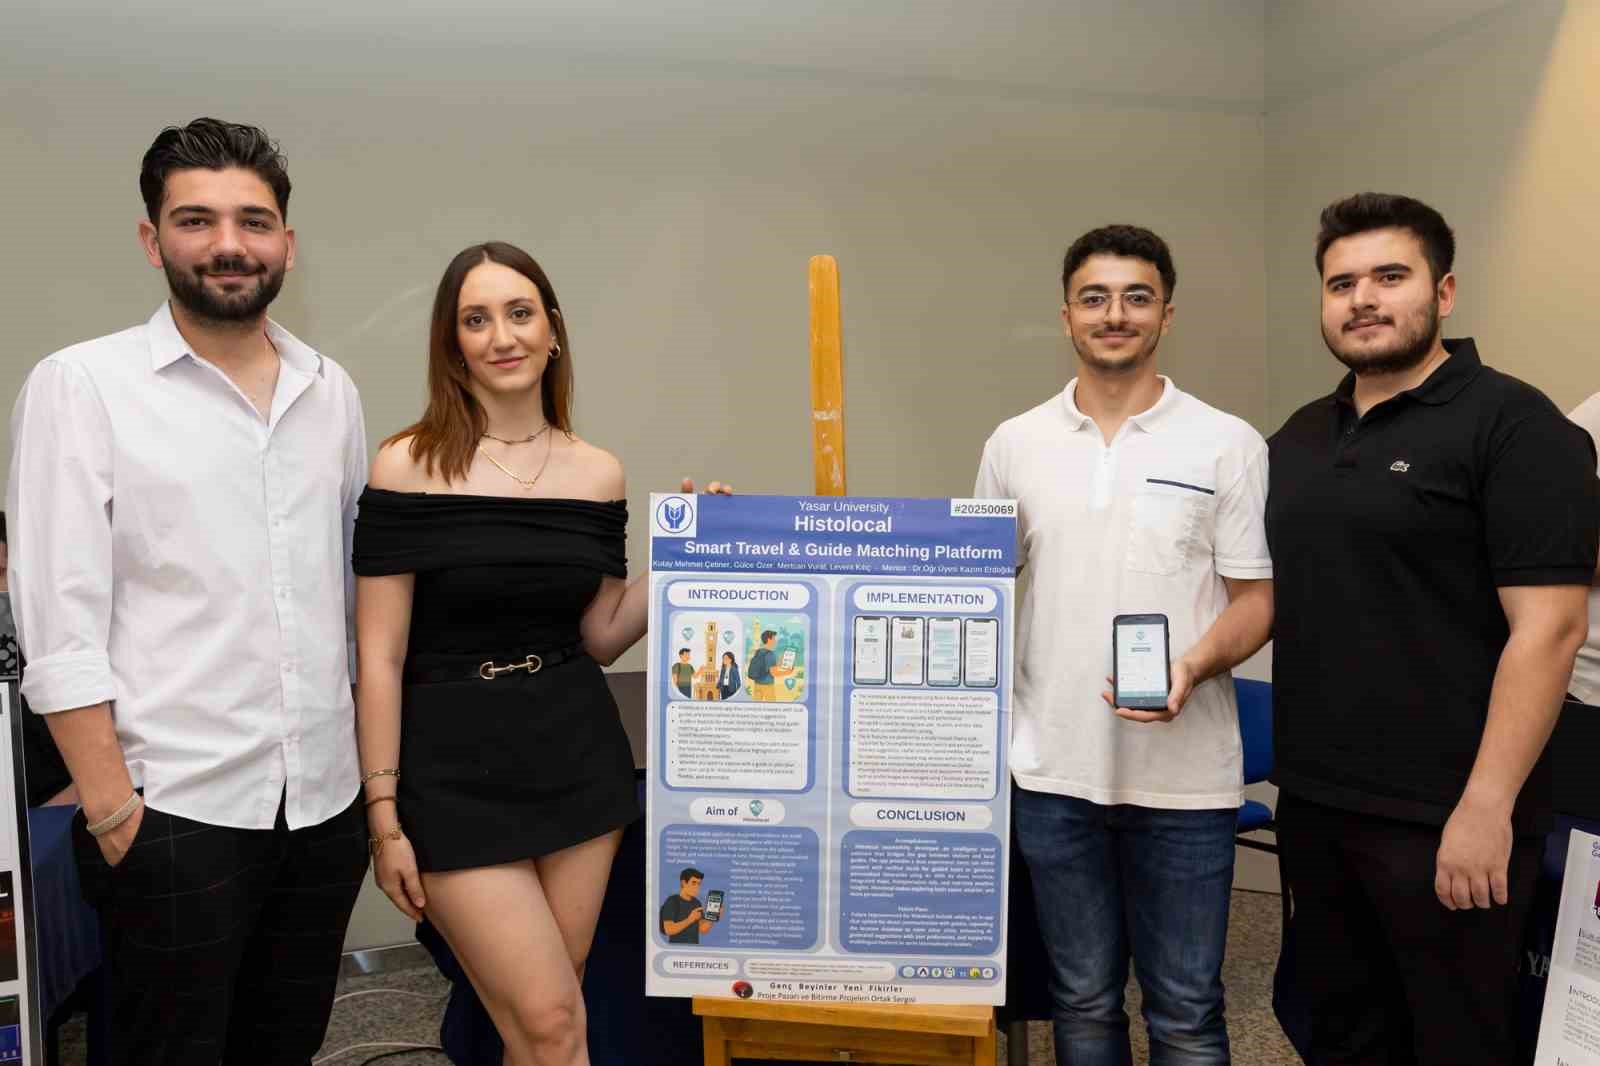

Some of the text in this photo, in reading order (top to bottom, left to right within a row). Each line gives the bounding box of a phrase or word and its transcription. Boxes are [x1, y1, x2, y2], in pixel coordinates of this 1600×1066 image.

[799, 501, 890, 514] Yasar University
[953, 503, 1015, 515] #20250069
[794, 515, 893, 533] Histolocal
[684, 540, 1003, 561] Smart Travel & Guide Matching Platform
[688, 589, 789, 601] INTRODUCTION
[866, 592, 984, 605] IMPLEMENTATION
[705, 806, 738, 816] Aim of
[877, 810, 966, 821] CONCLUSION
[672, 961, 729, 970] REFERENCES
[799, 983, 836, 991] Beyinler
[869, 985, 903, 993] Fikirler
